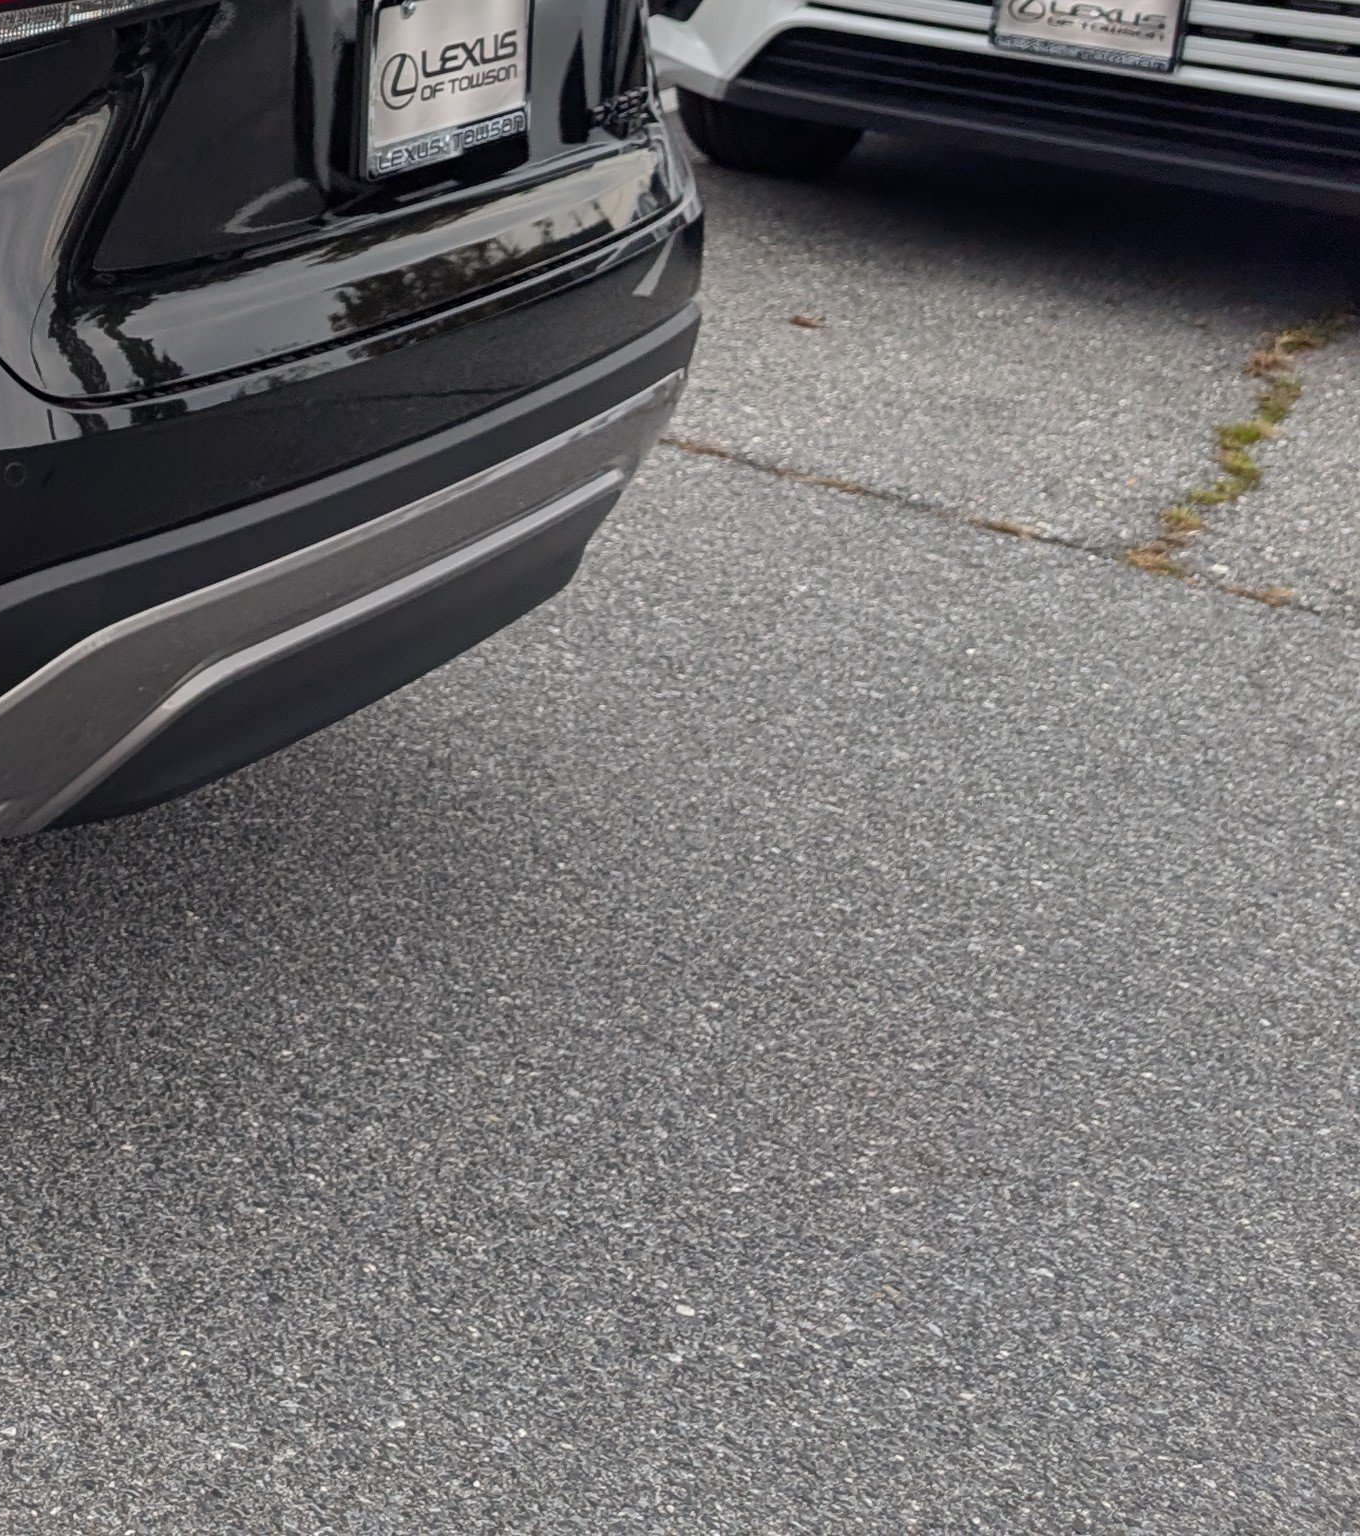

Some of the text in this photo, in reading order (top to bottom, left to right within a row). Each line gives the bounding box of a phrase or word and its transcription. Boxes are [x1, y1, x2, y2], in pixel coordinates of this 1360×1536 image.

[421, 29, 518, 78] LEXUS
[420, 81, 445, 102] OF
[378, 137, 443, 171] LEXUS
